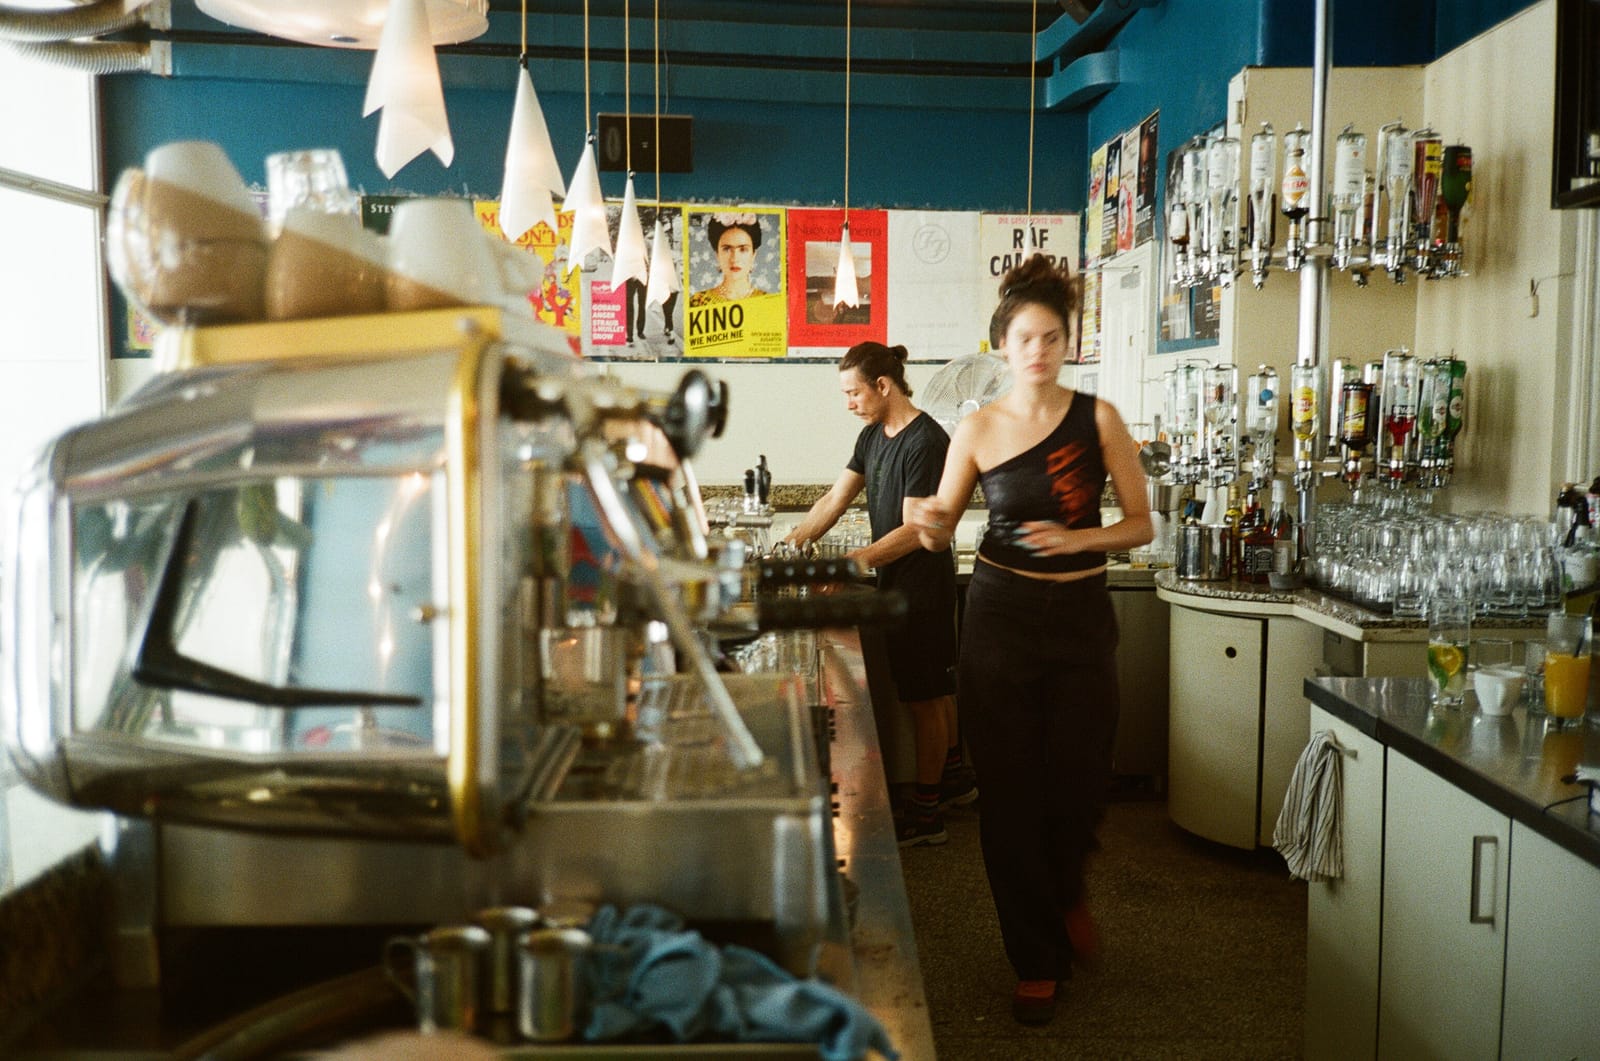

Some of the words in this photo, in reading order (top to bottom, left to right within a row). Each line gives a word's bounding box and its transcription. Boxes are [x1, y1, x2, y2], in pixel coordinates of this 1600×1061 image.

[689, 303, 744, 336] KINO
[689, 336, 704, 346] WIE
[706, 333, 728, 344] NOCH
[730, 330, 744, 339] NIE
